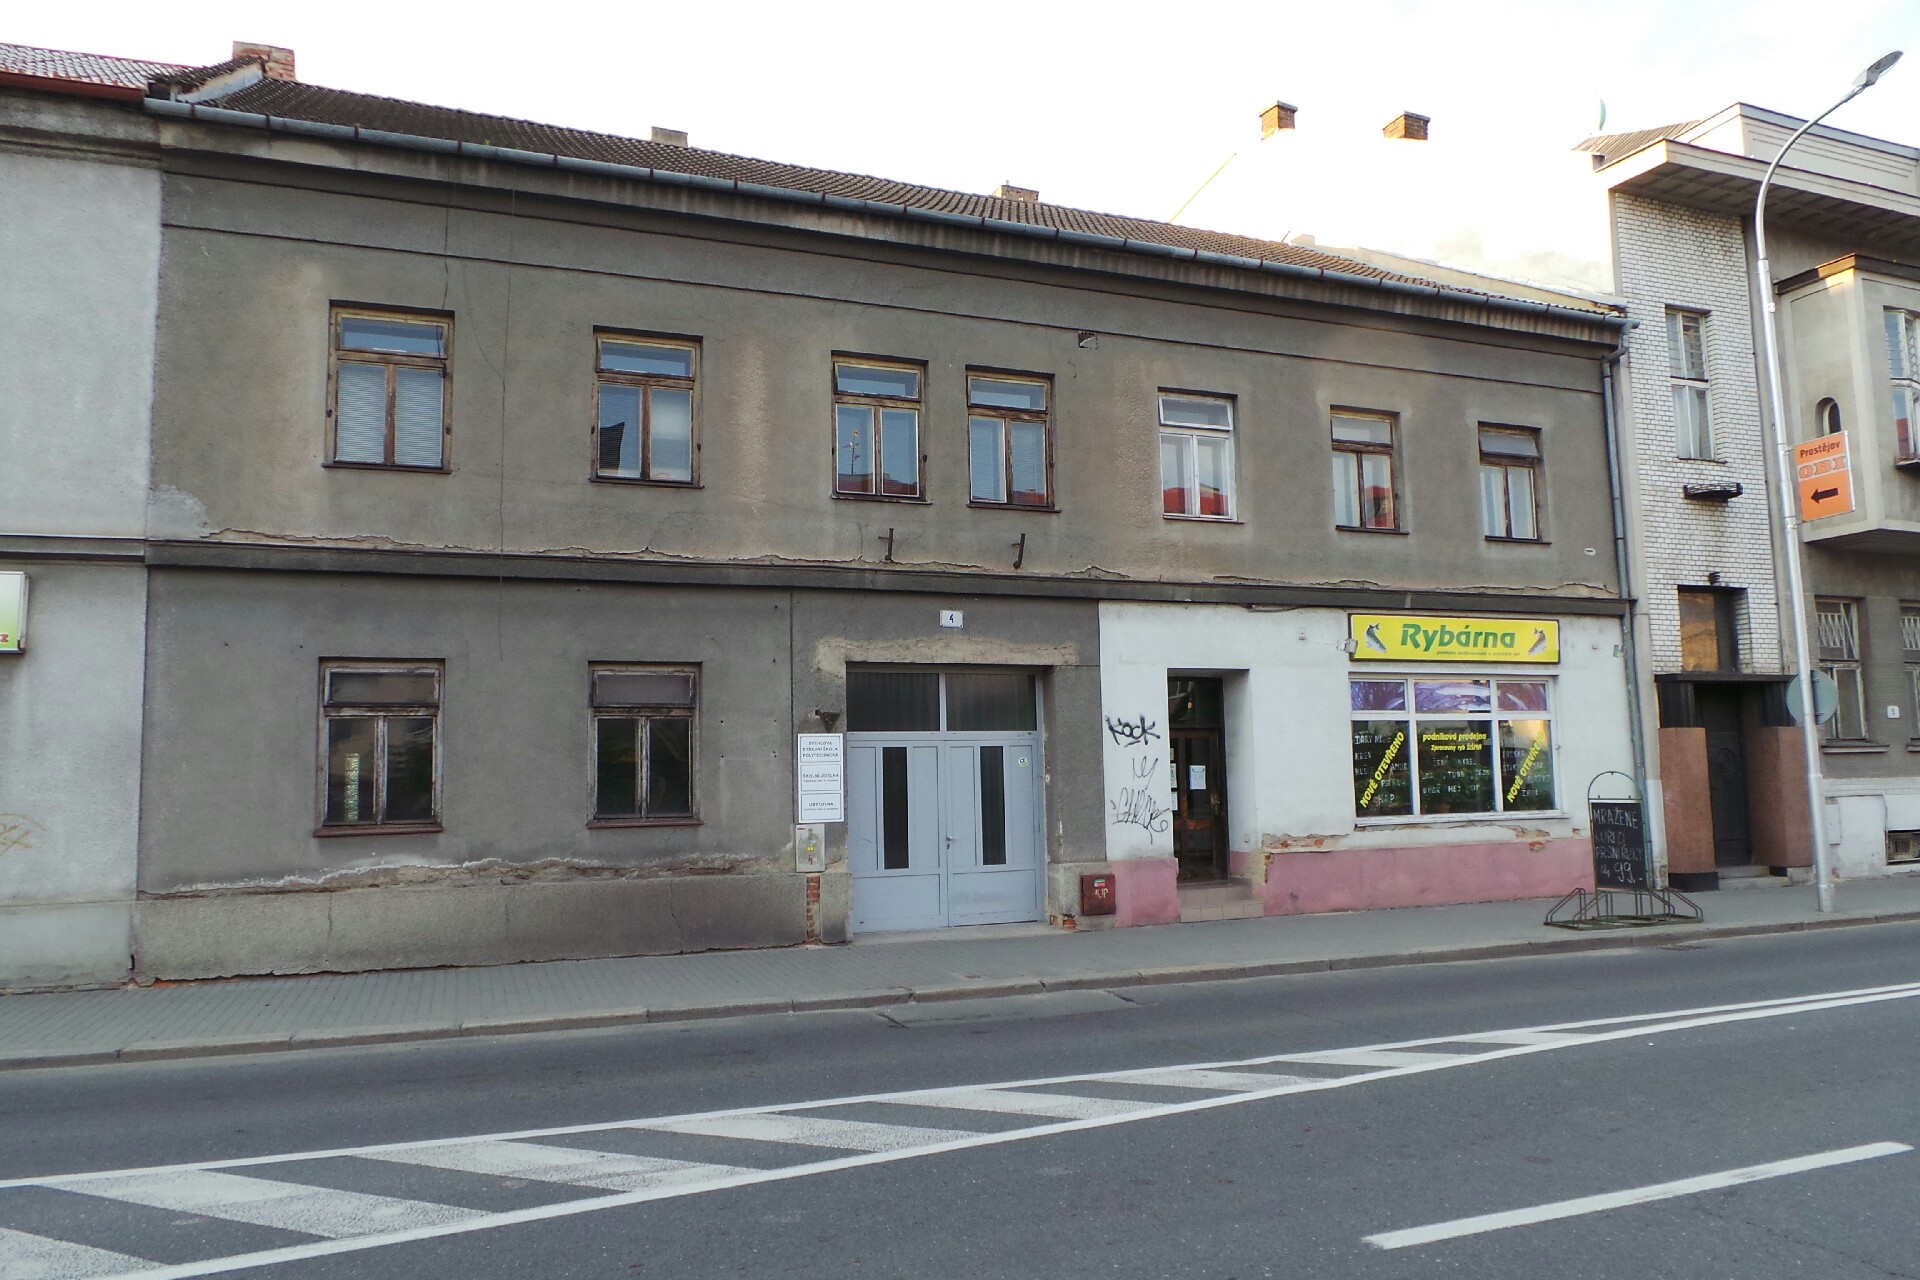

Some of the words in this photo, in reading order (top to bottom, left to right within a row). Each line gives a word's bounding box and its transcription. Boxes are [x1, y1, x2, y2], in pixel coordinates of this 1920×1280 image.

[1800, 440, 1841, 458] Prostějov
[1798, 455, 1847, 479] OBI
[949, 613, 954, 624] 4
[1401, 623, 1516, 652] Rybárna
[1458, 732, 1487, 742] prodejna
